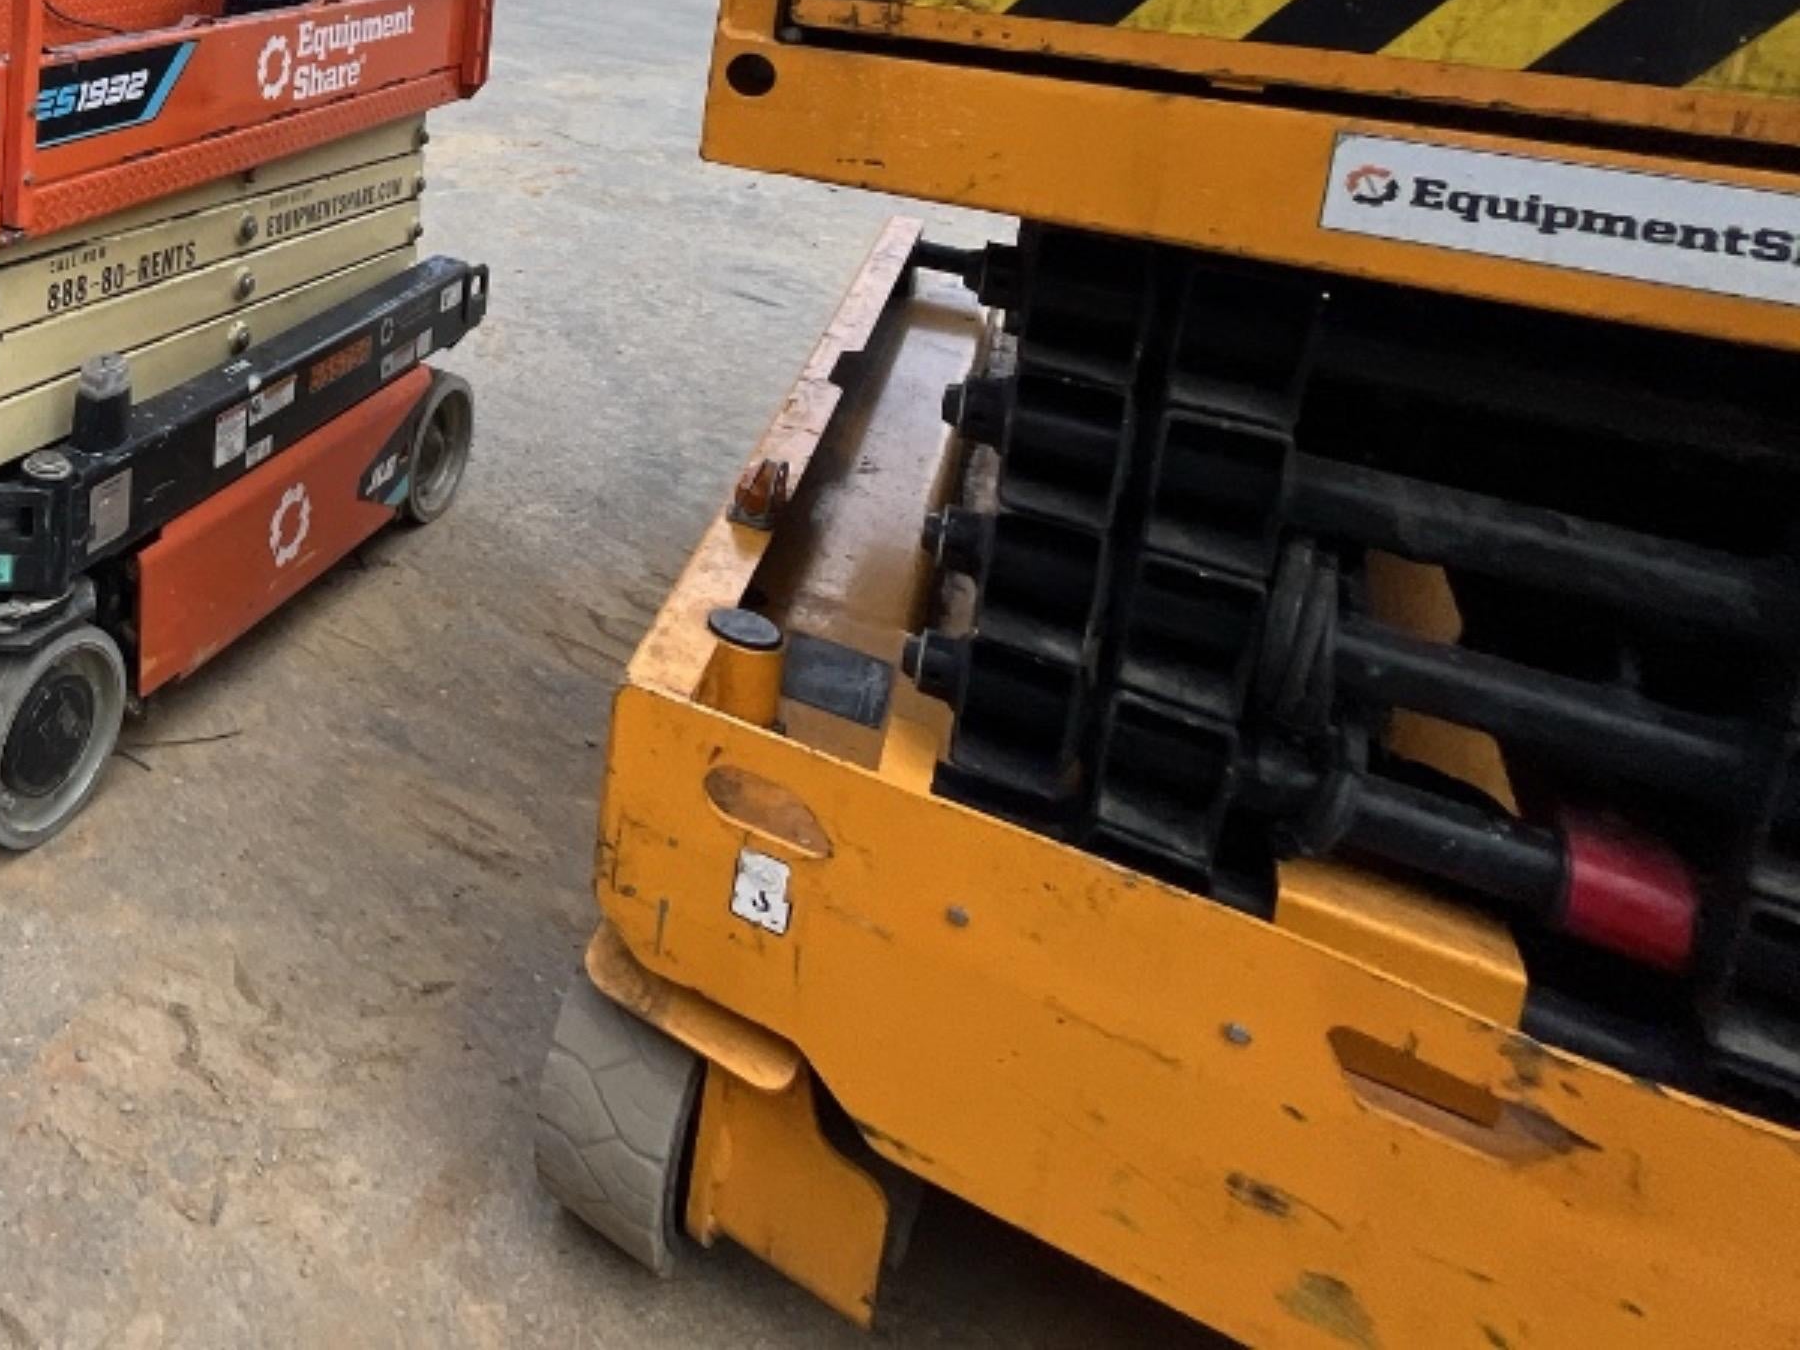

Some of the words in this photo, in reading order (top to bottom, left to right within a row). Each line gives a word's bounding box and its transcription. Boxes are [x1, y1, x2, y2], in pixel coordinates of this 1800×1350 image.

[296, 4, 416, 61] Equipment
[36, 68, 151, 121] ES1932
[292, 59, 362, 101] Share
[1409, 176, 1800, 267] EquipmentS
[47, 239, 196, 312] 888-80-RENTS
